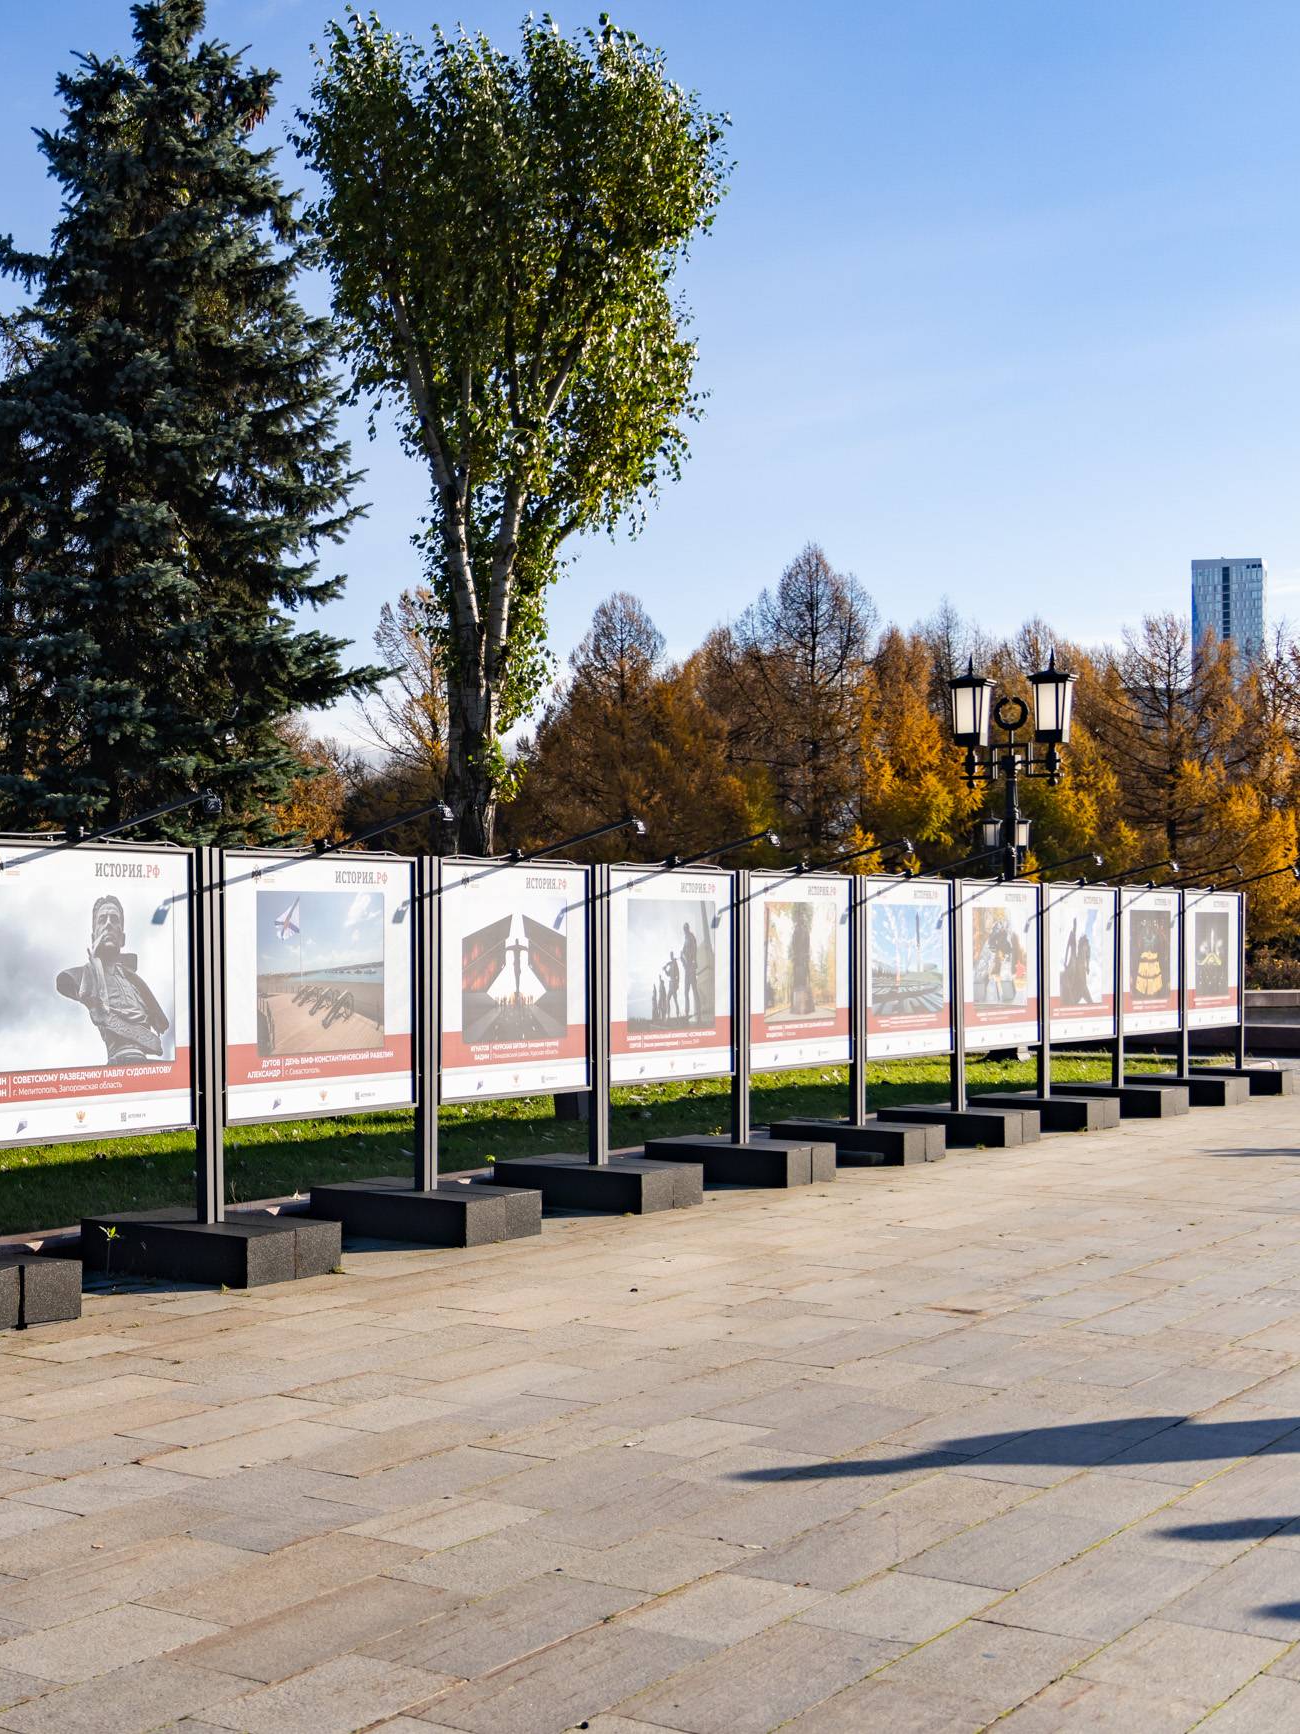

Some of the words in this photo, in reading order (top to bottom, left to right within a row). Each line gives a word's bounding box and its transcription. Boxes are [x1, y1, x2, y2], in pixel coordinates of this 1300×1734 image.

[95, 863, 160, 879] ИСТОРИЯ.РФ
[335, 871, 388, 884] ИСТОРИЯ.РФ
[525, 877, 568, 890] ИСТОРИЯ.РФ
[262, 1059, 281, 1069] ДУТОВ
[285, 1058, 300, 1066] ДЕНЬ
[12, 1074, 58, 1085] СОВЕТСКОМУ
[59, 1071, 102, 1082] РАЗВЕДЧИКУ
[103, 1069, 125, 1078] ПАВЛУ
[126, 1065, 172, 1076] СУДОПЛАТОВУ
[247, 1070, 281, 1079] АЛЕКСАНДР
[99, 1081, 123, 1089] область
